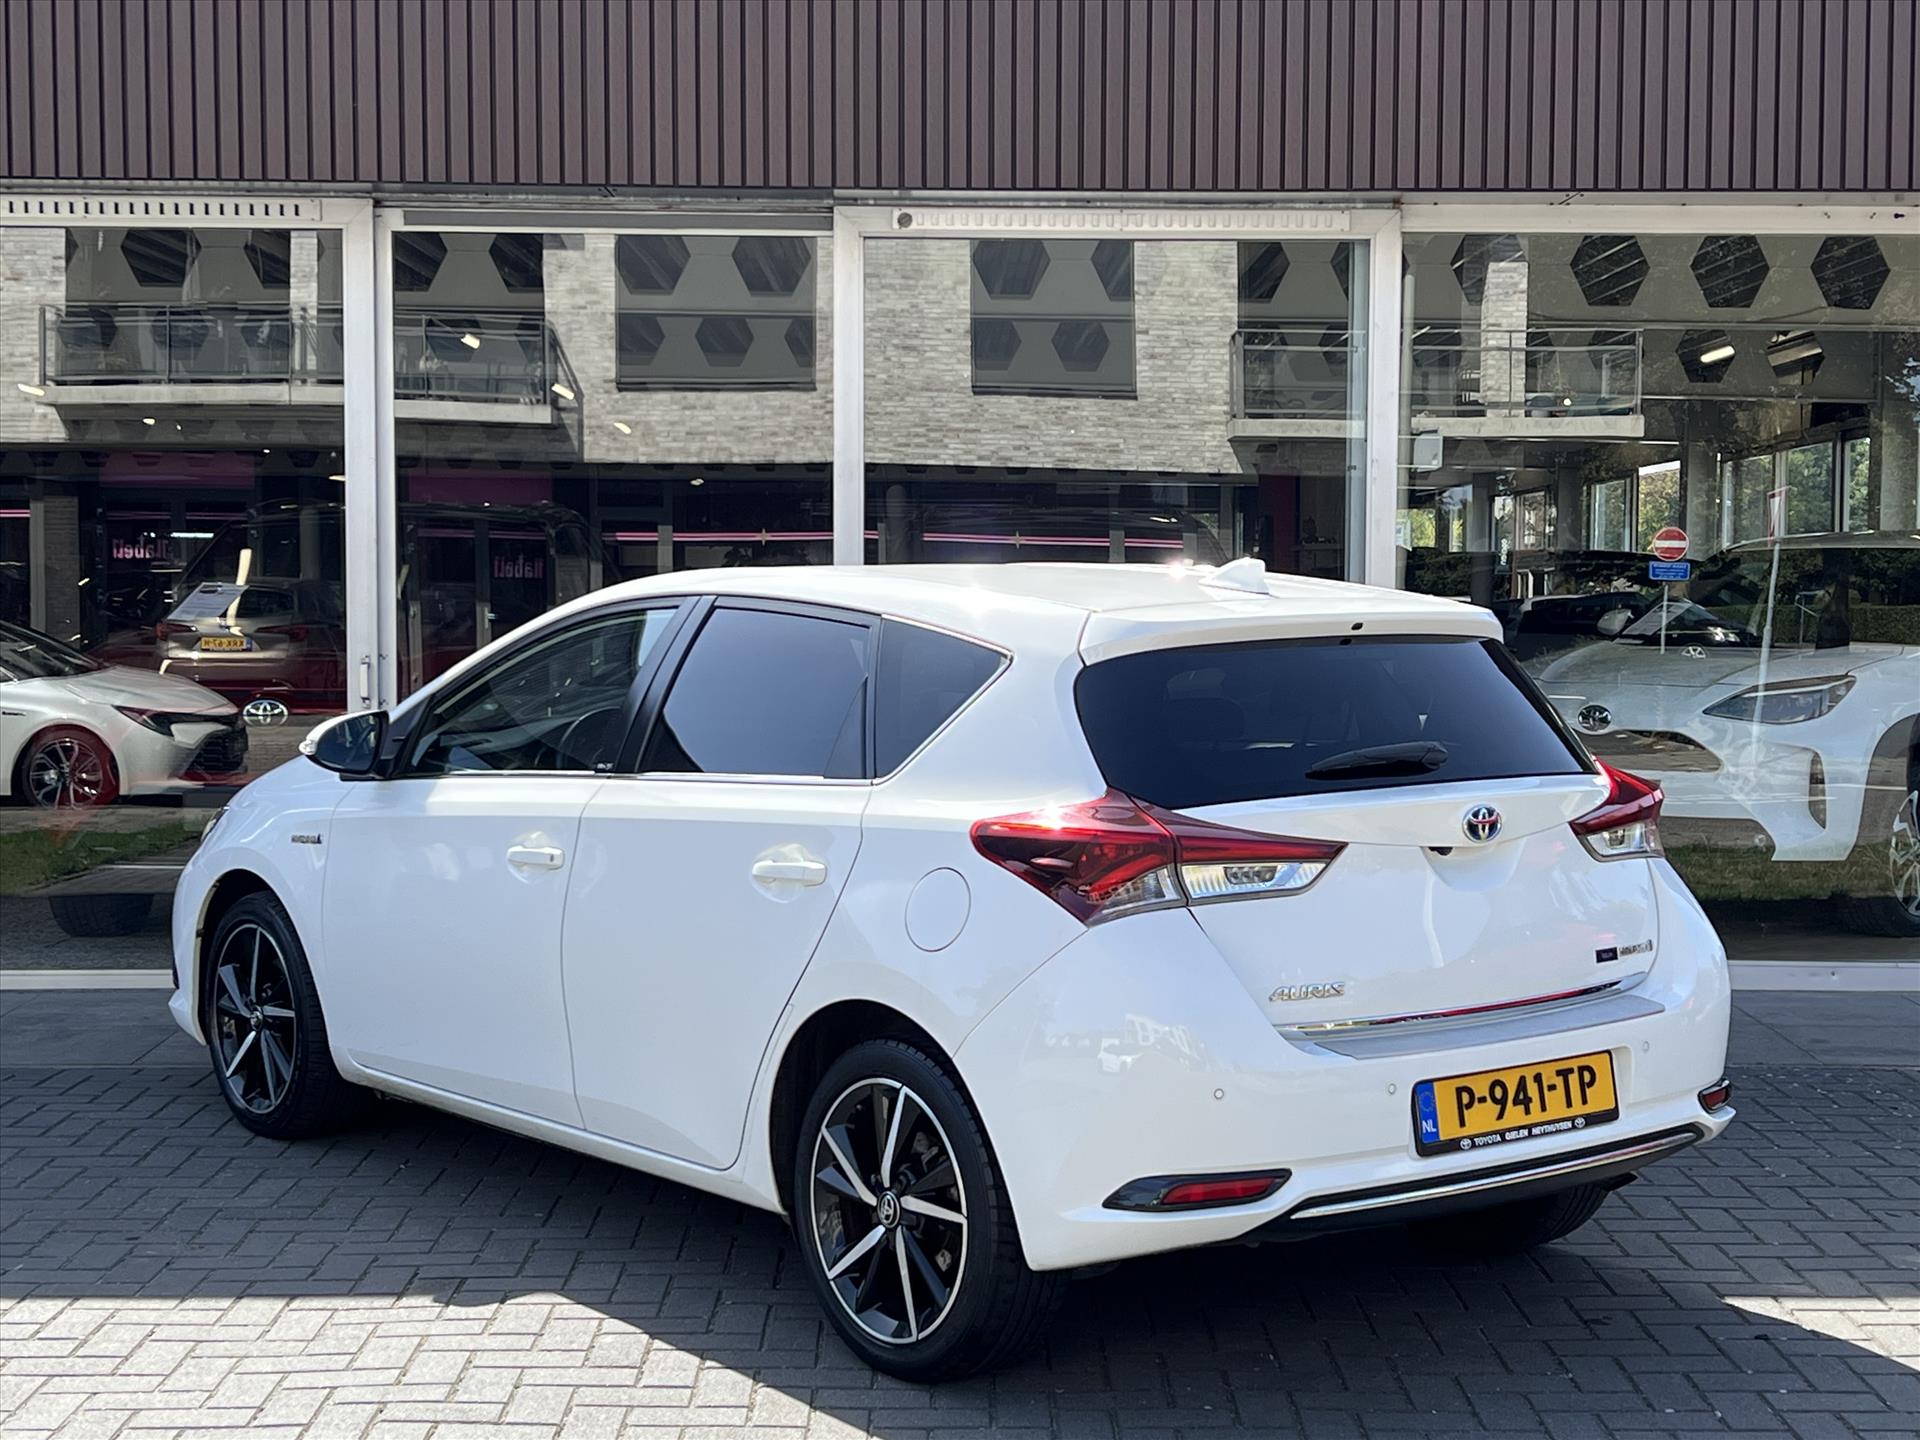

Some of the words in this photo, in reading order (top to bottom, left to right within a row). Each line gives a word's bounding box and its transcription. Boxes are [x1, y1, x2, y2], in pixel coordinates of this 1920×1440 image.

[1269, 982, 1344, 1001] AURIS
[1455, 1064, 1597, 1128] P-941-TP
[1422, 1119, 1437, 1134] NL
[1473, 1133, 1502, 1146] TOYOTA
